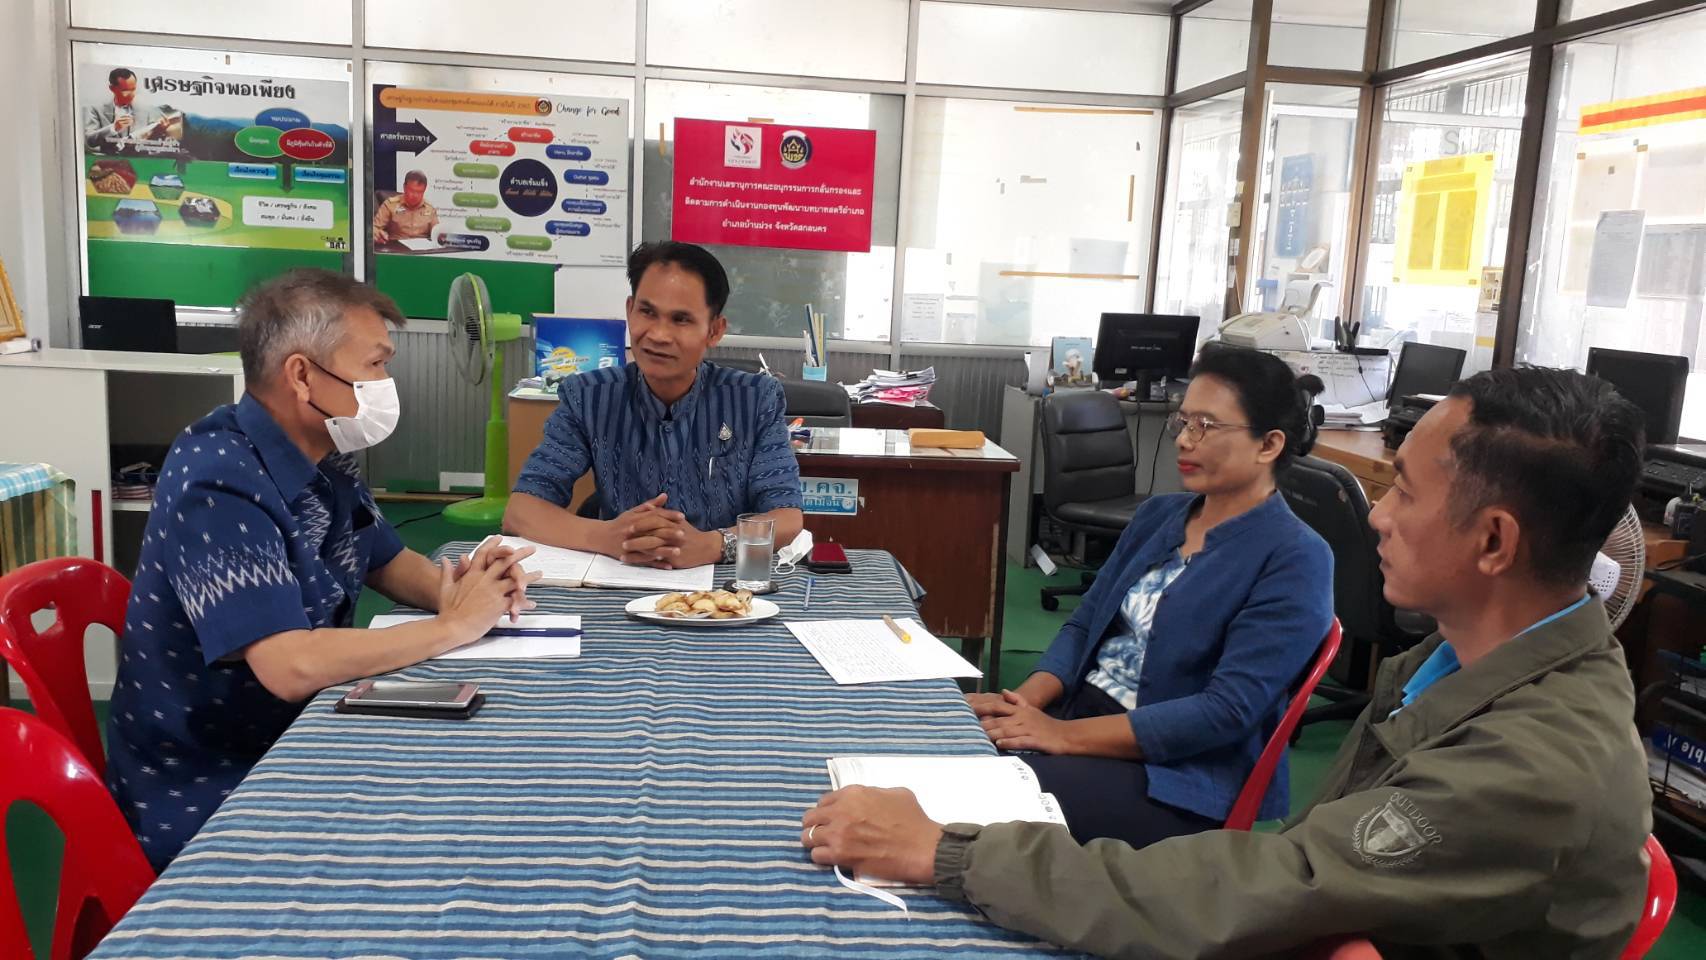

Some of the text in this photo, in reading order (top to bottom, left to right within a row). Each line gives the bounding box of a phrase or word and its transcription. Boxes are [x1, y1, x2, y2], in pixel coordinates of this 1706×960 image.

[144, 75, 297, 100] เศรษฐกิจพอเพียง
[556, 103, 620, 117] Change for Good
[722, 218, 828, 233] อำเภอบ้านม่วง จังหวัดสกลนคร
